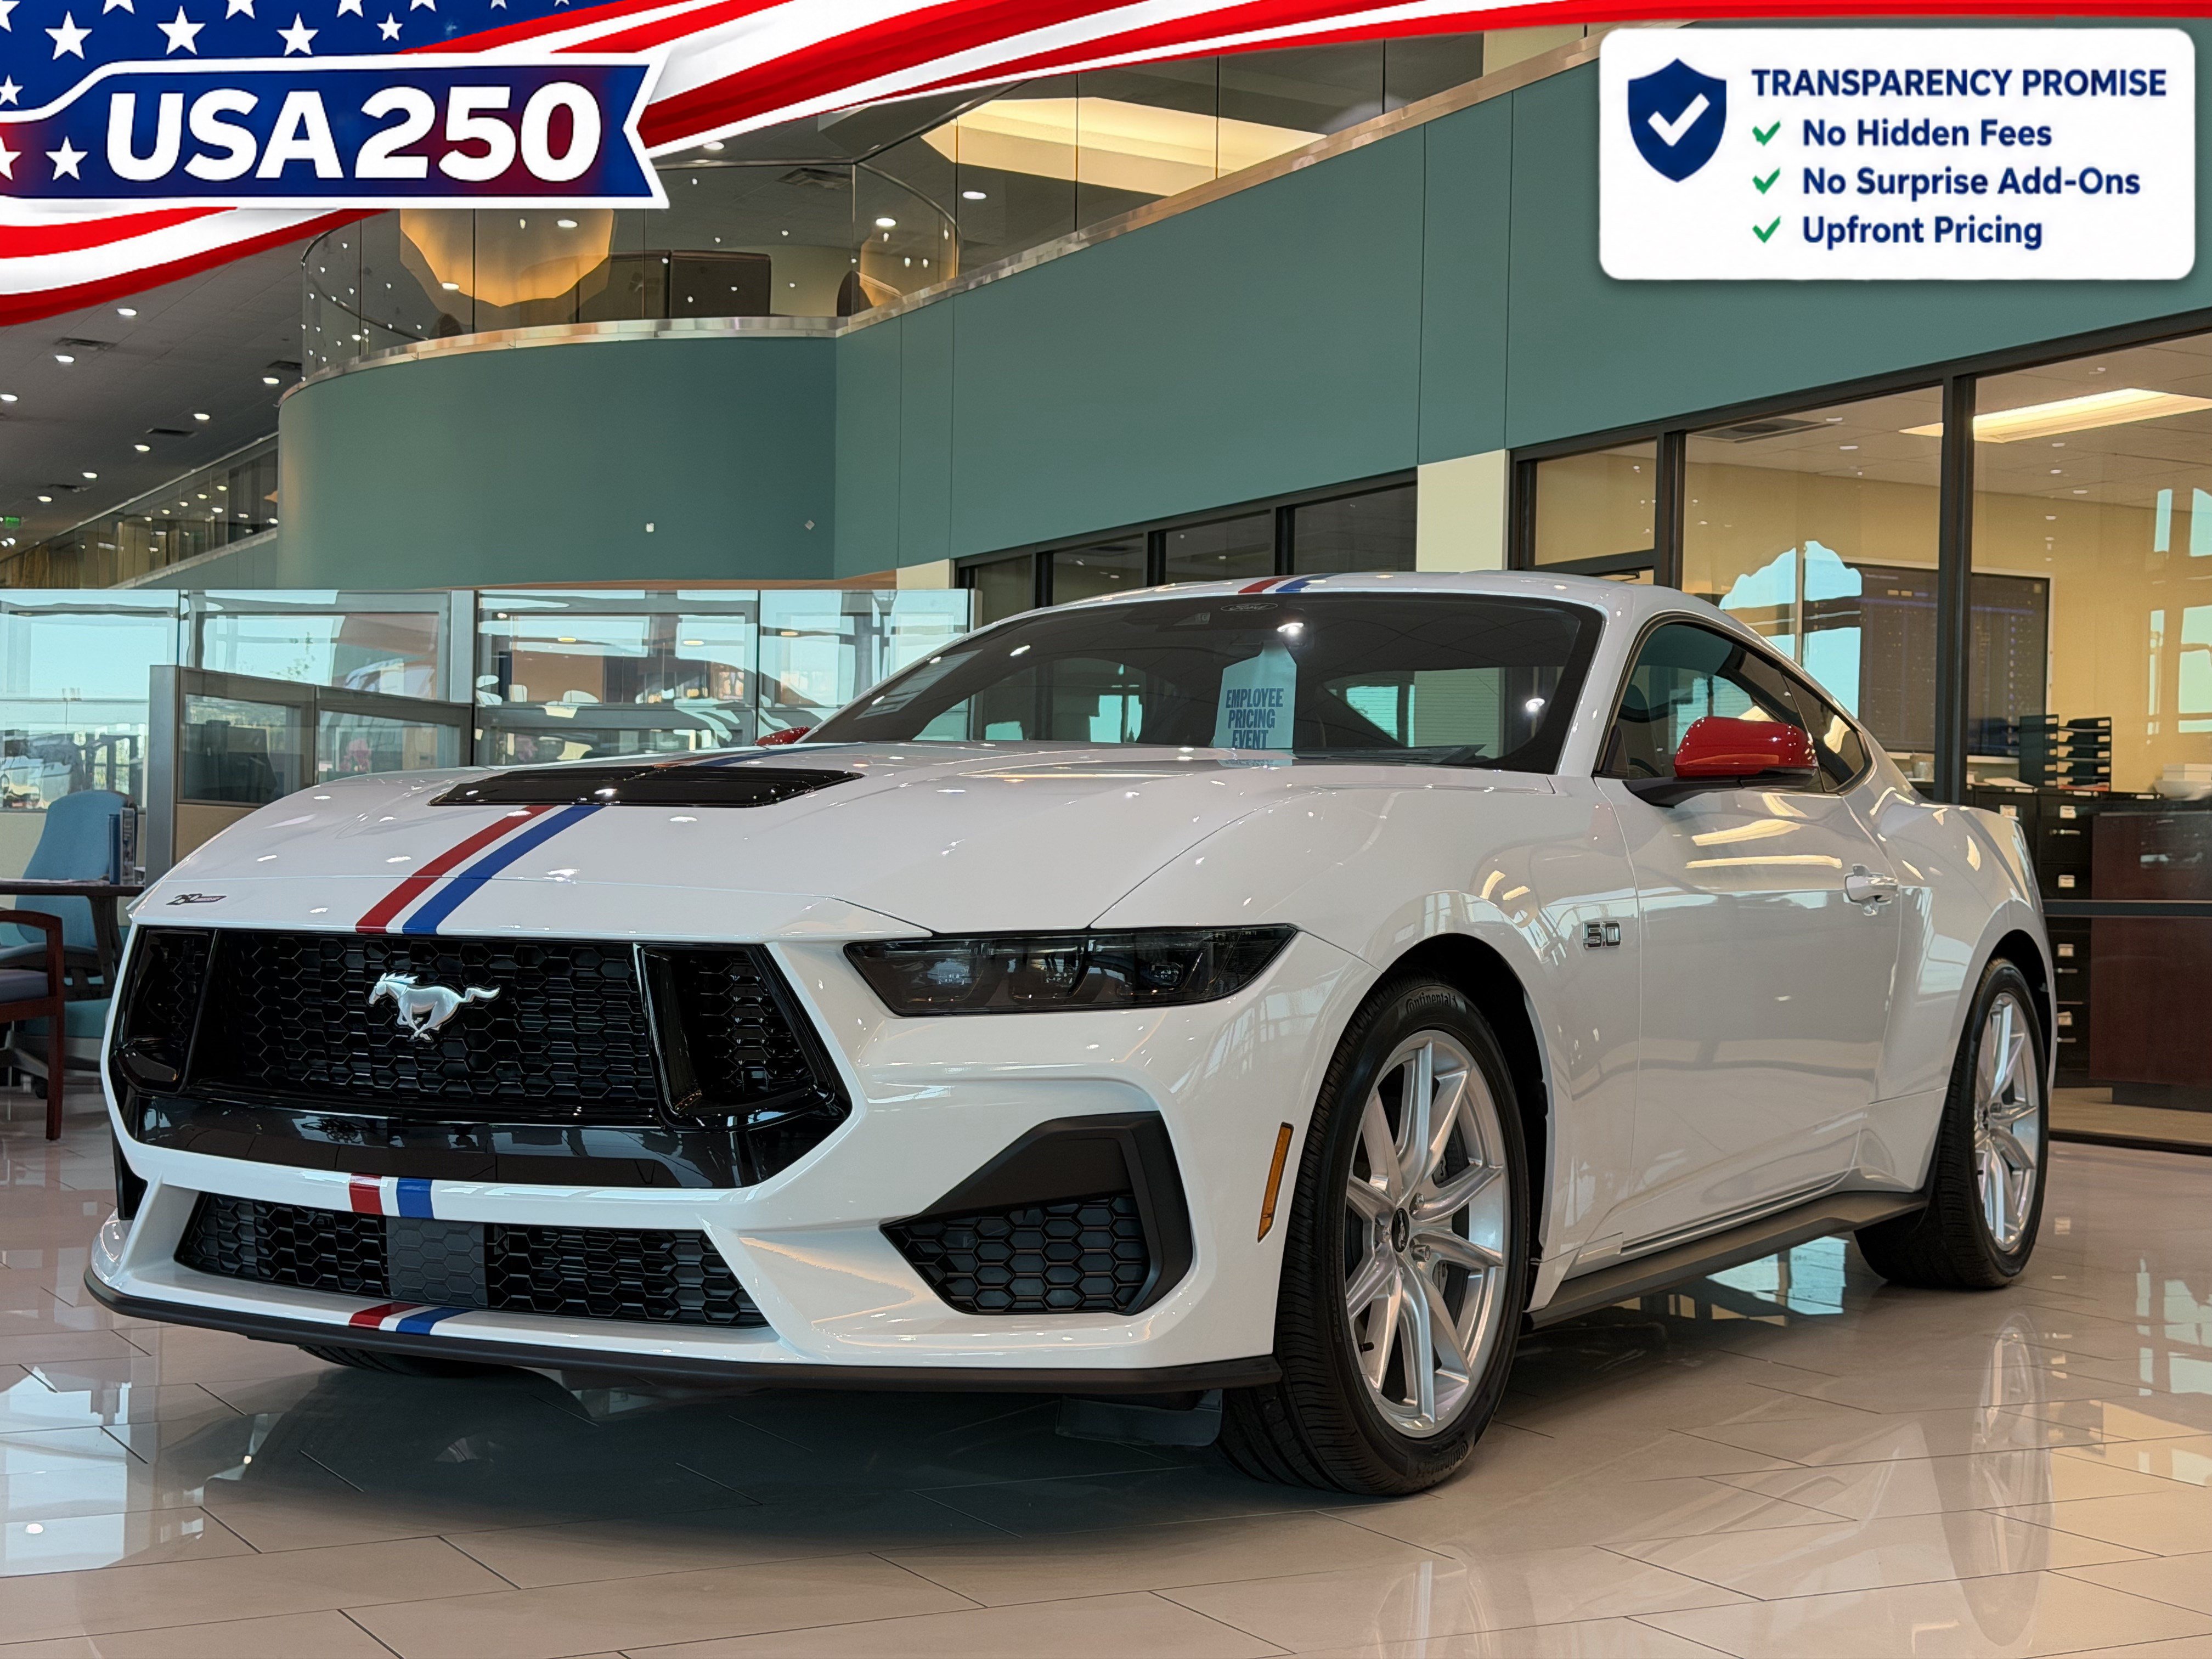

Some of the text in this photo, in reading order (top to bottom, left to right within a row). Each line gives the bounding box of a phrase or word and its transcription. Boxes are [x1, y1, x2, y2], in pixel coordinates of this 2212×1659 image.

[1226, 688, 1284, 708] EMPLOYEE
[1228, 709, 1275, 729] PRICING
[1232, 730, 1268, 749] EVENT
